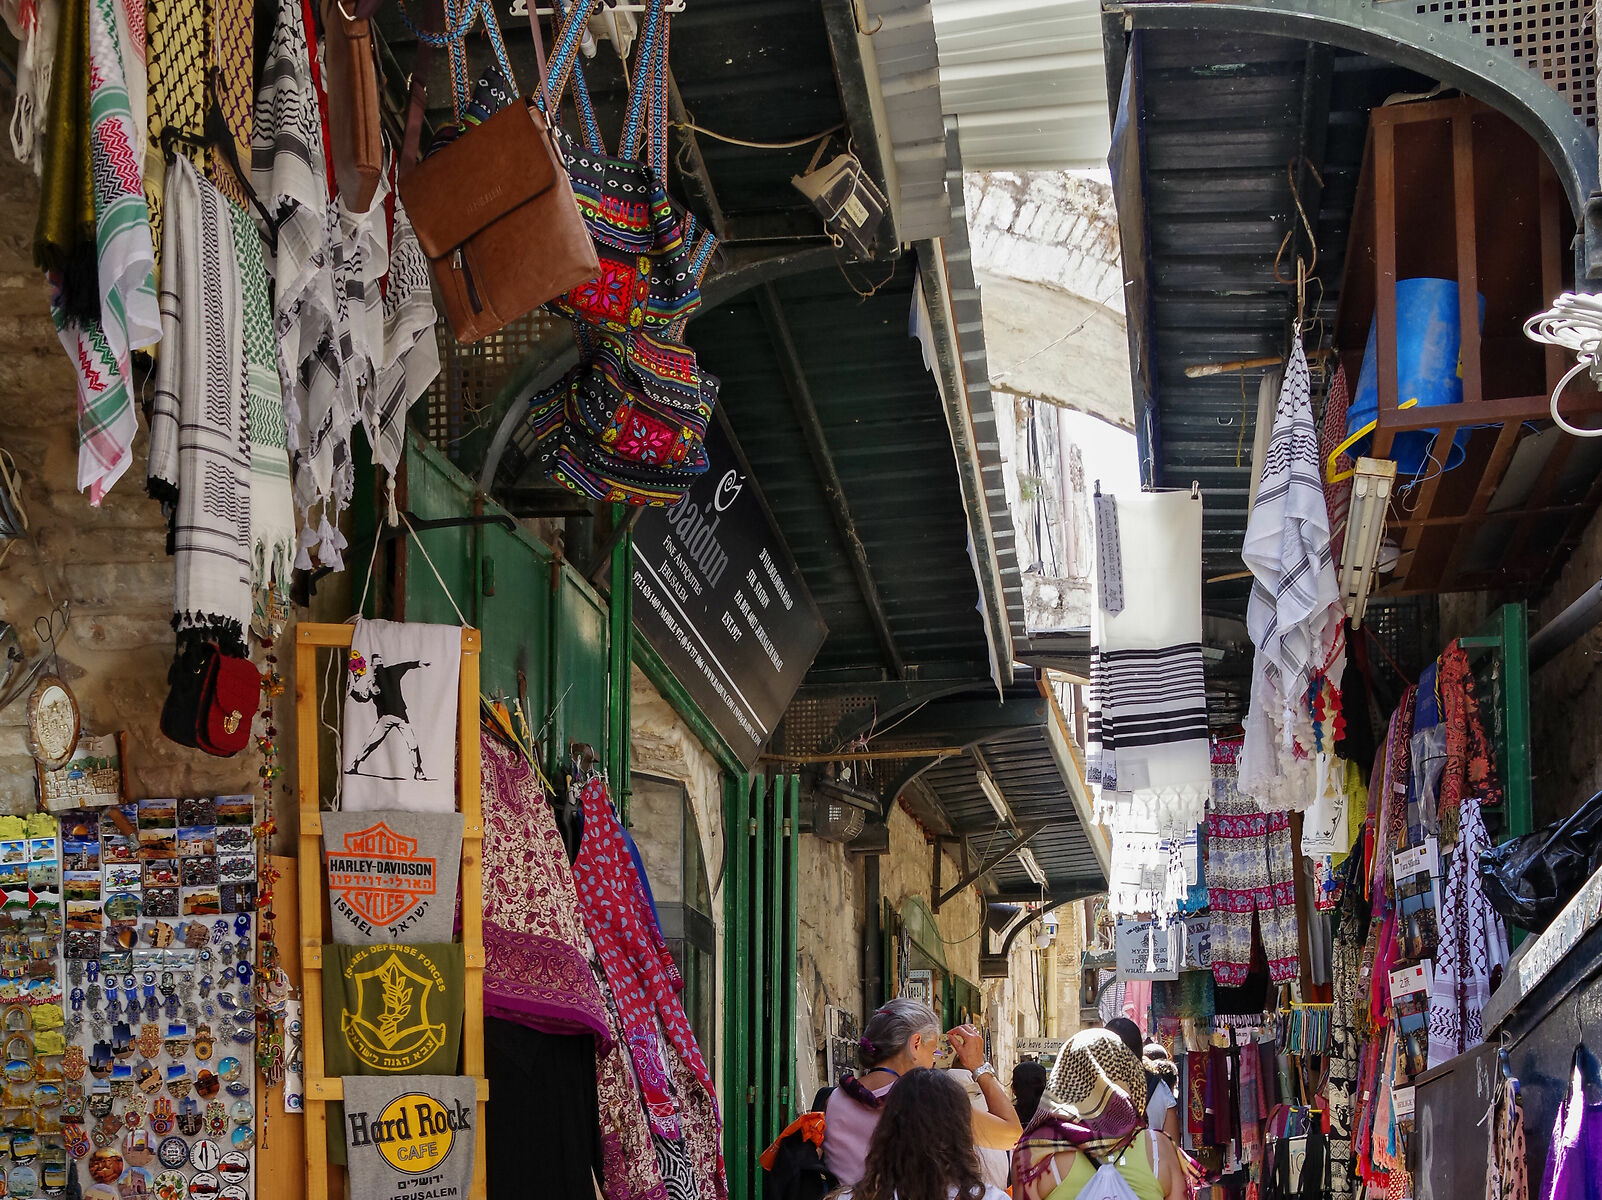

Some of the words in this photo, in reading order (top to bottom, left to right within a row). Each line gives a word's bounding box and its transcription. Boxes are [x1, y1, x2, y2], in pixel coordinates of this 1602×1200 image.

[754, 581, 770, 608] STATION
[353, 831, 409, 857] MOTOR
[330, 859, 432, 876] HARLEY-DAVIDSON
[333, 897, 375, 937] ISRAEL
[354, 891, 405, 920] CYCLES
[388, 901, 429, 938] ישראל
[369, 944, 418, 957] DEFENSE
[418, 953, 446, 993] FORCES
[1016, 1039, 1026, 1048] We
[1028, 1039, 1042, 1049] have
[1043, 1040, 1064, 1051] stamp
[348, 1106, 412, 1147] Hard
[415, 1098, 472, 1137] Rock
[397, 1142, 439, 1162] CAFE
[398, 1174, 444, 1190] ירושלים
